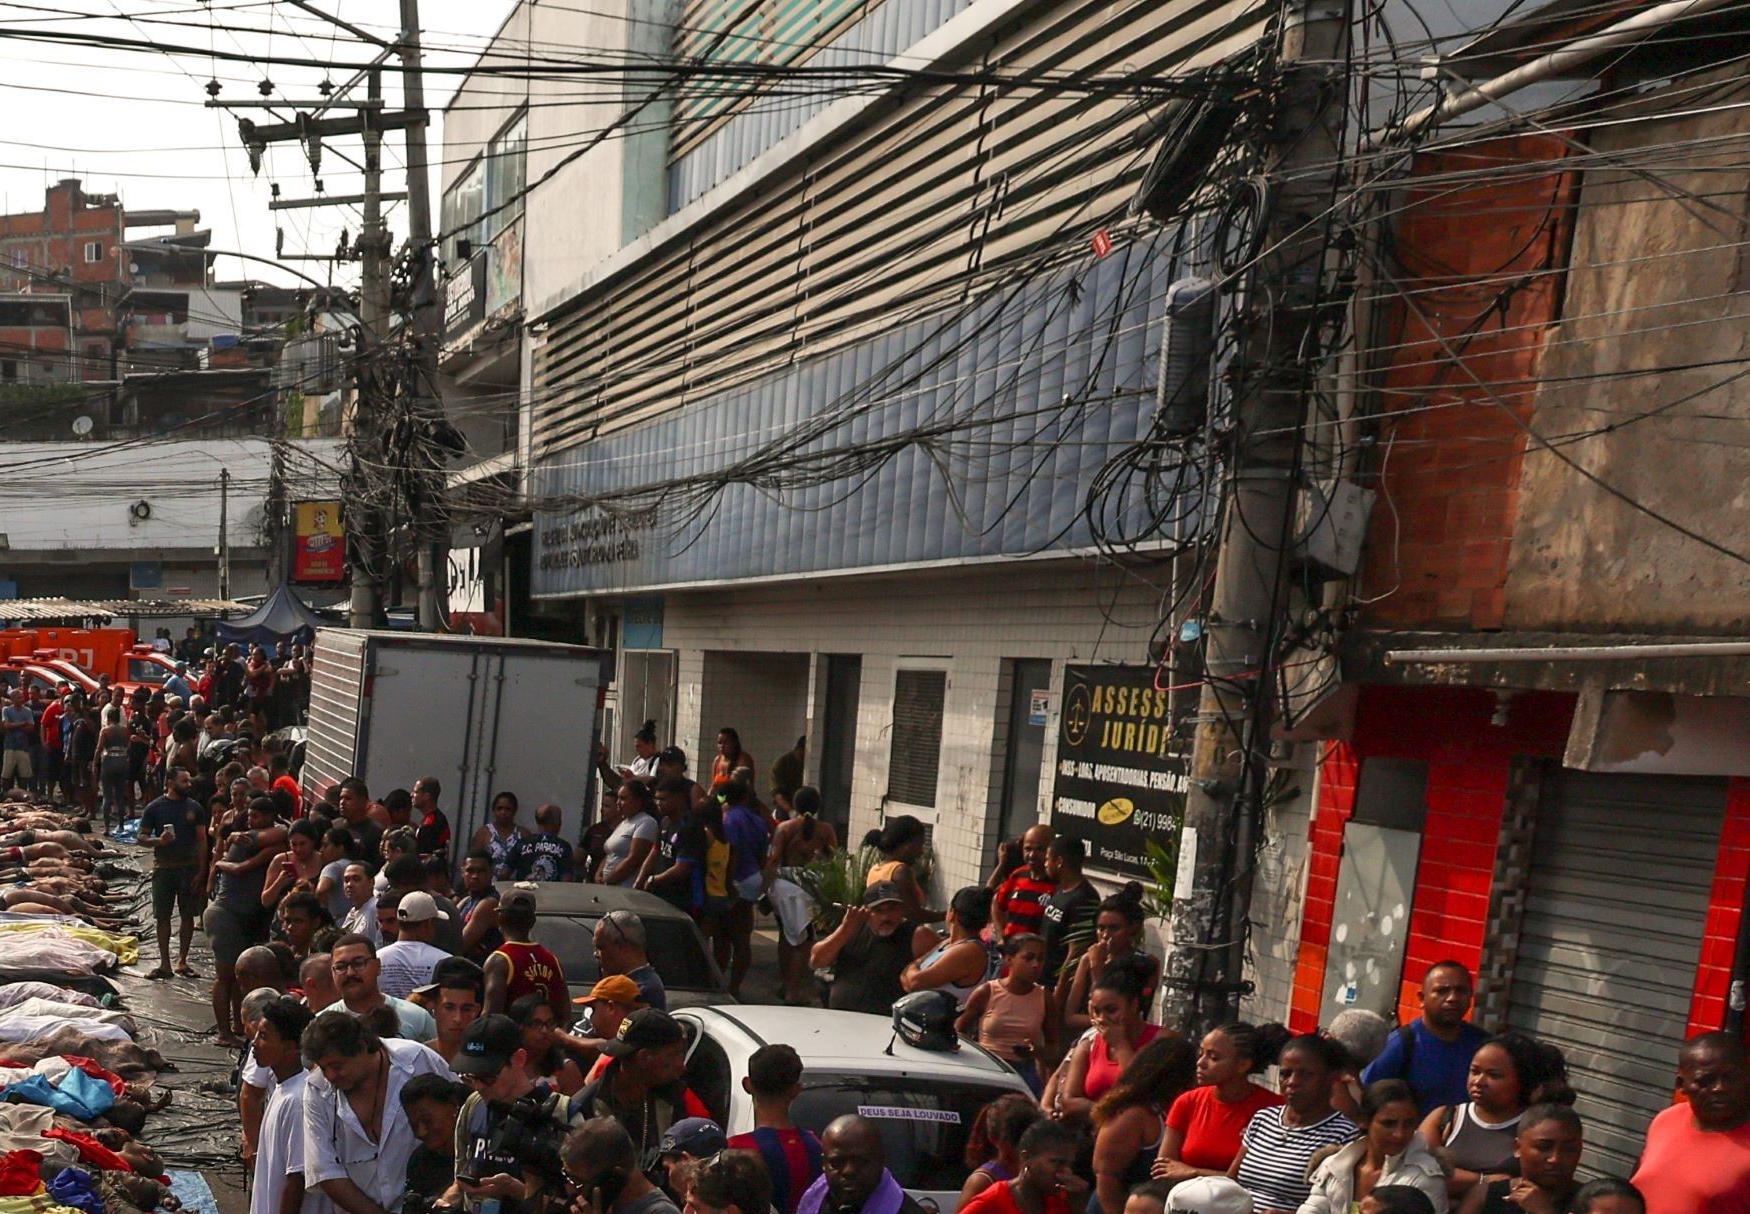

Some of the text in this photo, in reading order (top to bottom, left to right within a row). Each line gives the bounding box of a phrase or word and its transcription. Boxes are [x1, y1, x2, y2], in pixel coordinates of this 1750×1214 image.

[1092, 685, 1167, 719] ASSESS
[860, 1107, 958, 1122] DEUS SEJA LOUVADO
